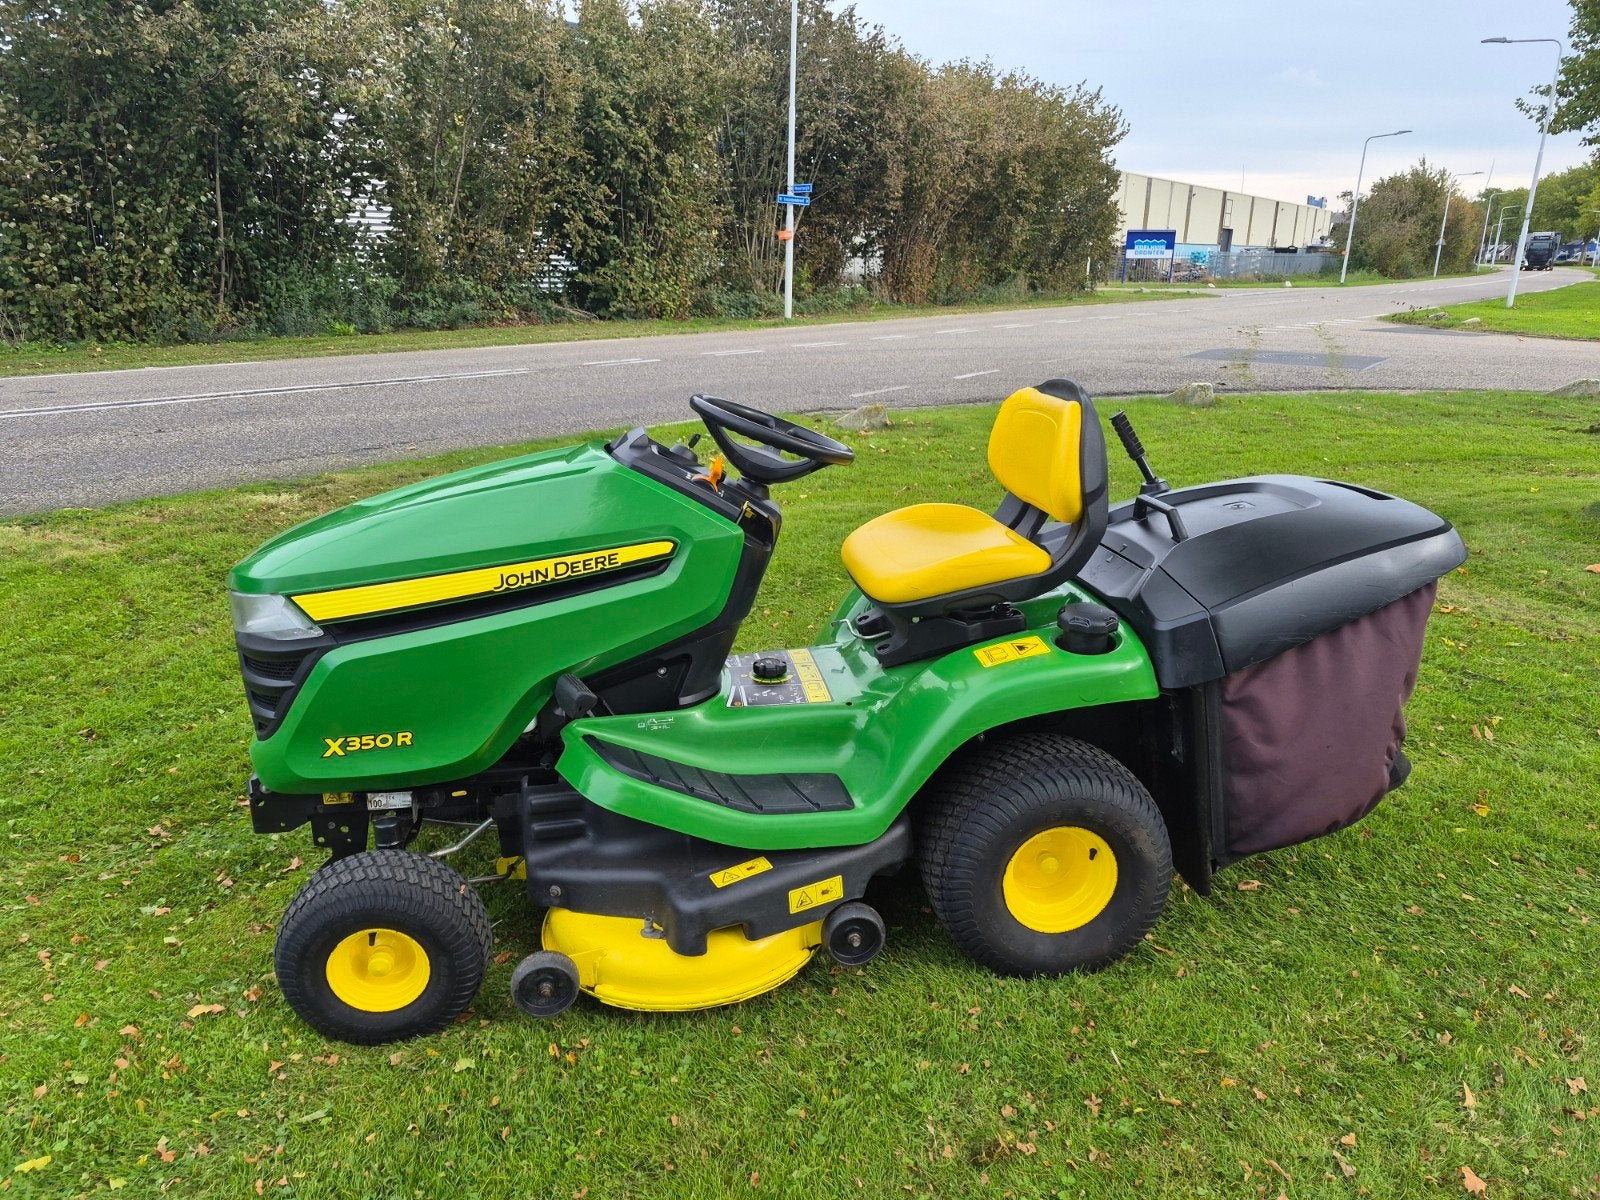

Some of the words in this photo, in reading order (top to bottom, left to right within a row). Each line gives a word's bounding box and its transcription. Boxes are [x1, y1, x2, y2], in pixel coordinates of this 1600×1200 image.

[493, 567, 549, 590] JOHN
[554, 552, 619, 578] DEERE
[369, 799, 383, 808] 100
